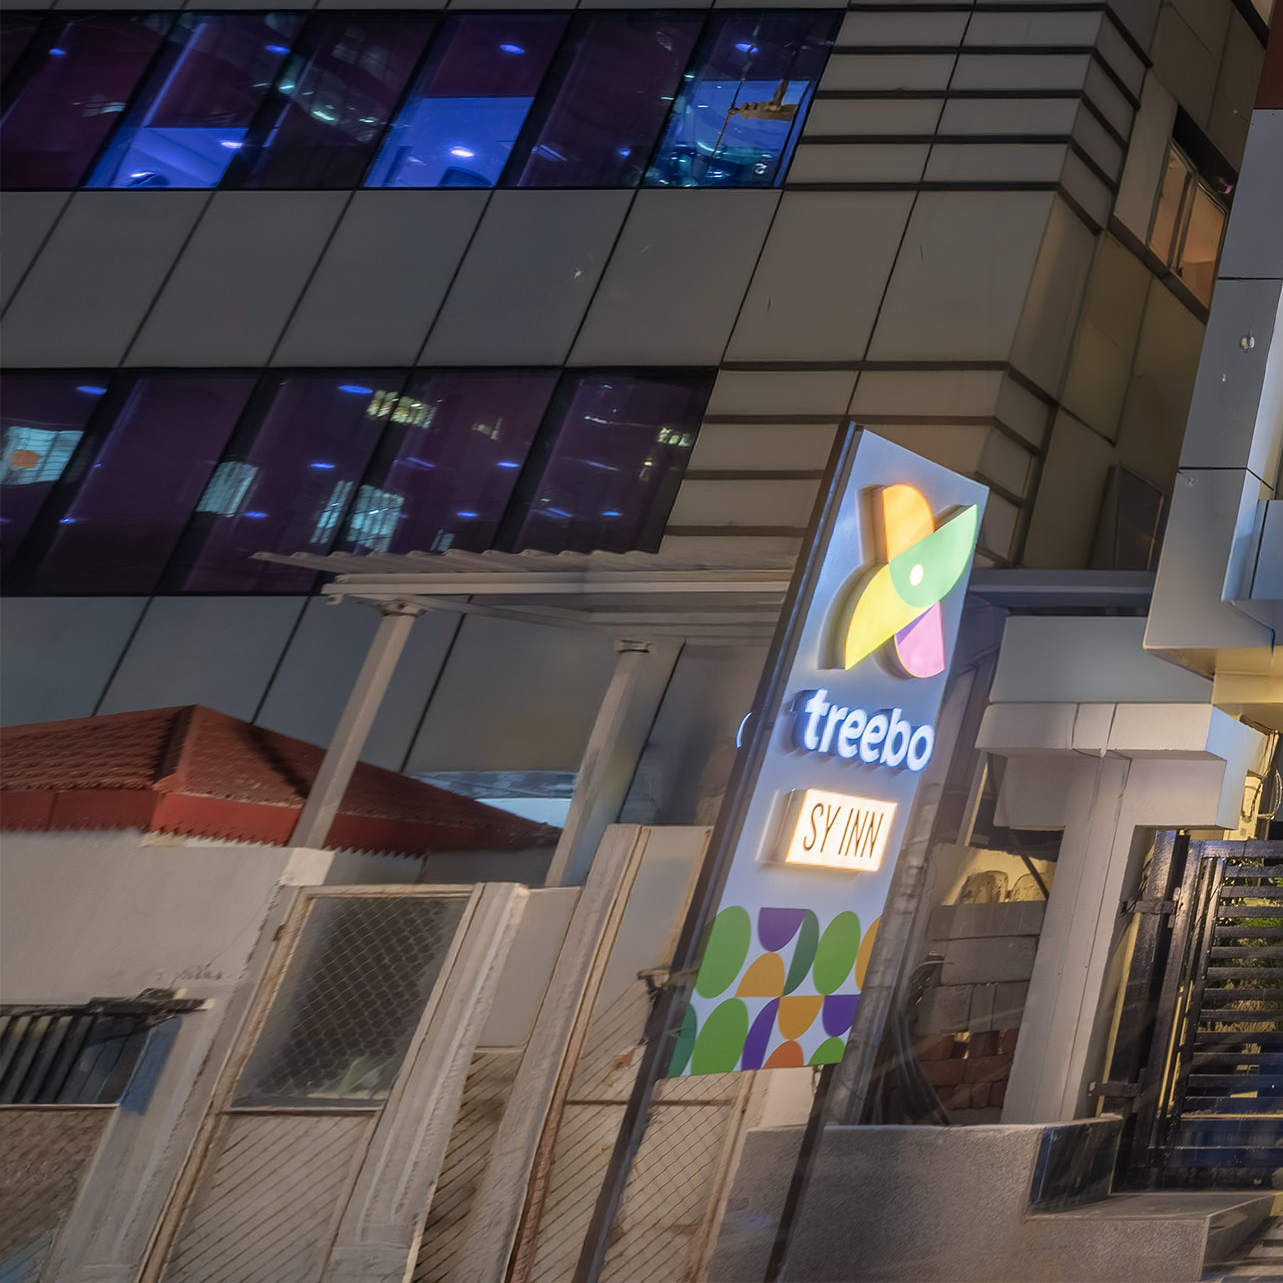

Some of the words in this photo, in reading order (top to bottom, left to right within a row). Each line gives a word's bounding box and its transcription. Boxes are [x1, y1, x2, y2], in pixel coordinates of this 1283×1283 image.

[804, 688, 935, 773] treebo
[803, 802, 840, 852] SY
[837, 808, 883, 859] INN
